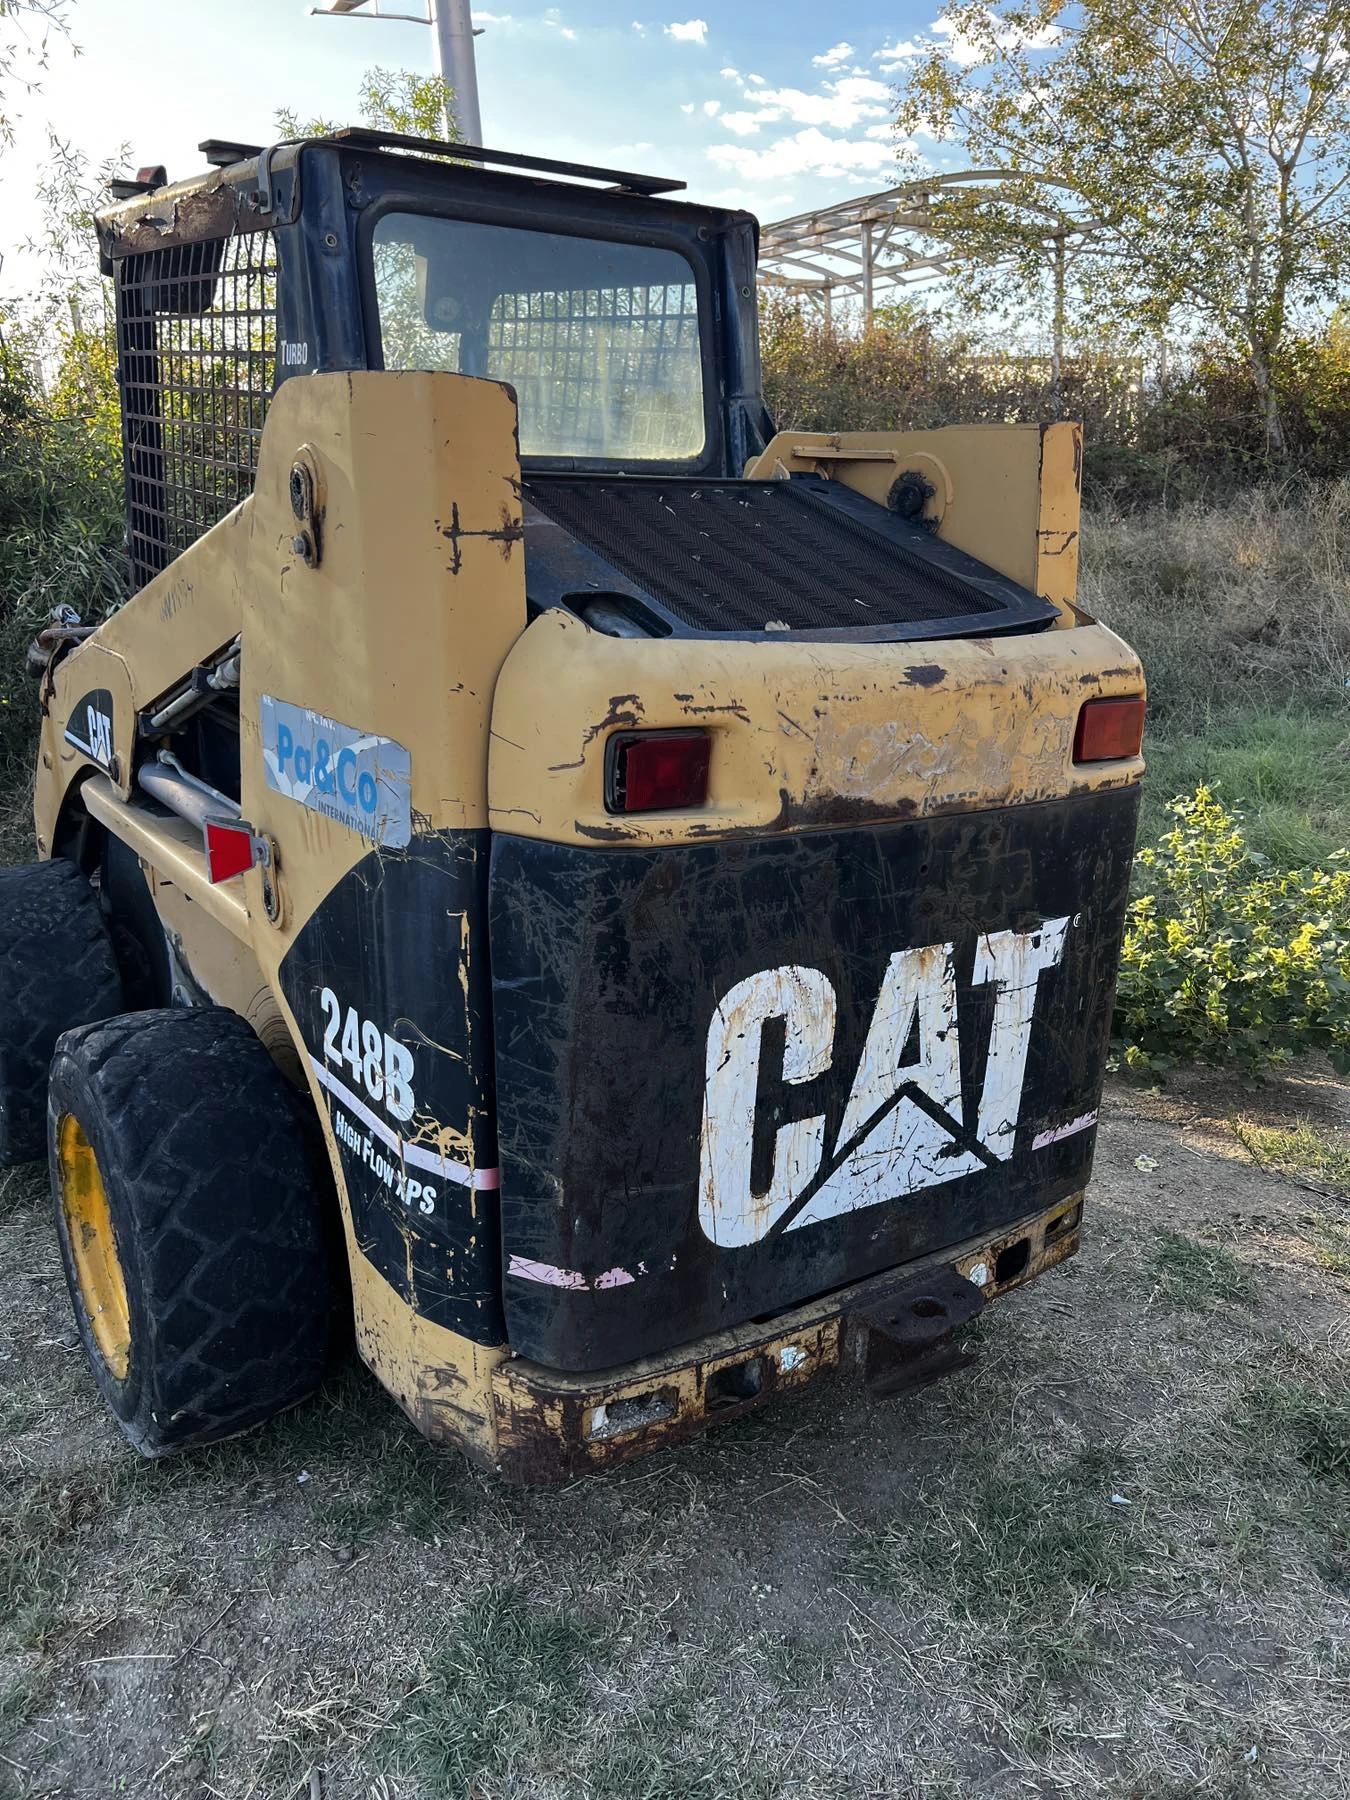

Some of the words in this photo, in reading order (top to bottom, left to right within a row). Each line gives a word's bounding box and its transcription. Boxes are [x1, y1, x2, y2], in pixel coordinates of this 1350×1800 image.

[280, 340, 308, 366] TURBO
[87, 704, 112, 767] CAT
[277, 722, 378, 814] Pa&Co
[320, 987, 415, 1122] 248B
[697, 914, 1072, 1249] CAT
[335, 1110, 361, 1158] HIGH
[362, 1143, 395, 1186] FLOW
[395, 1169, 437, 1215] XPS
